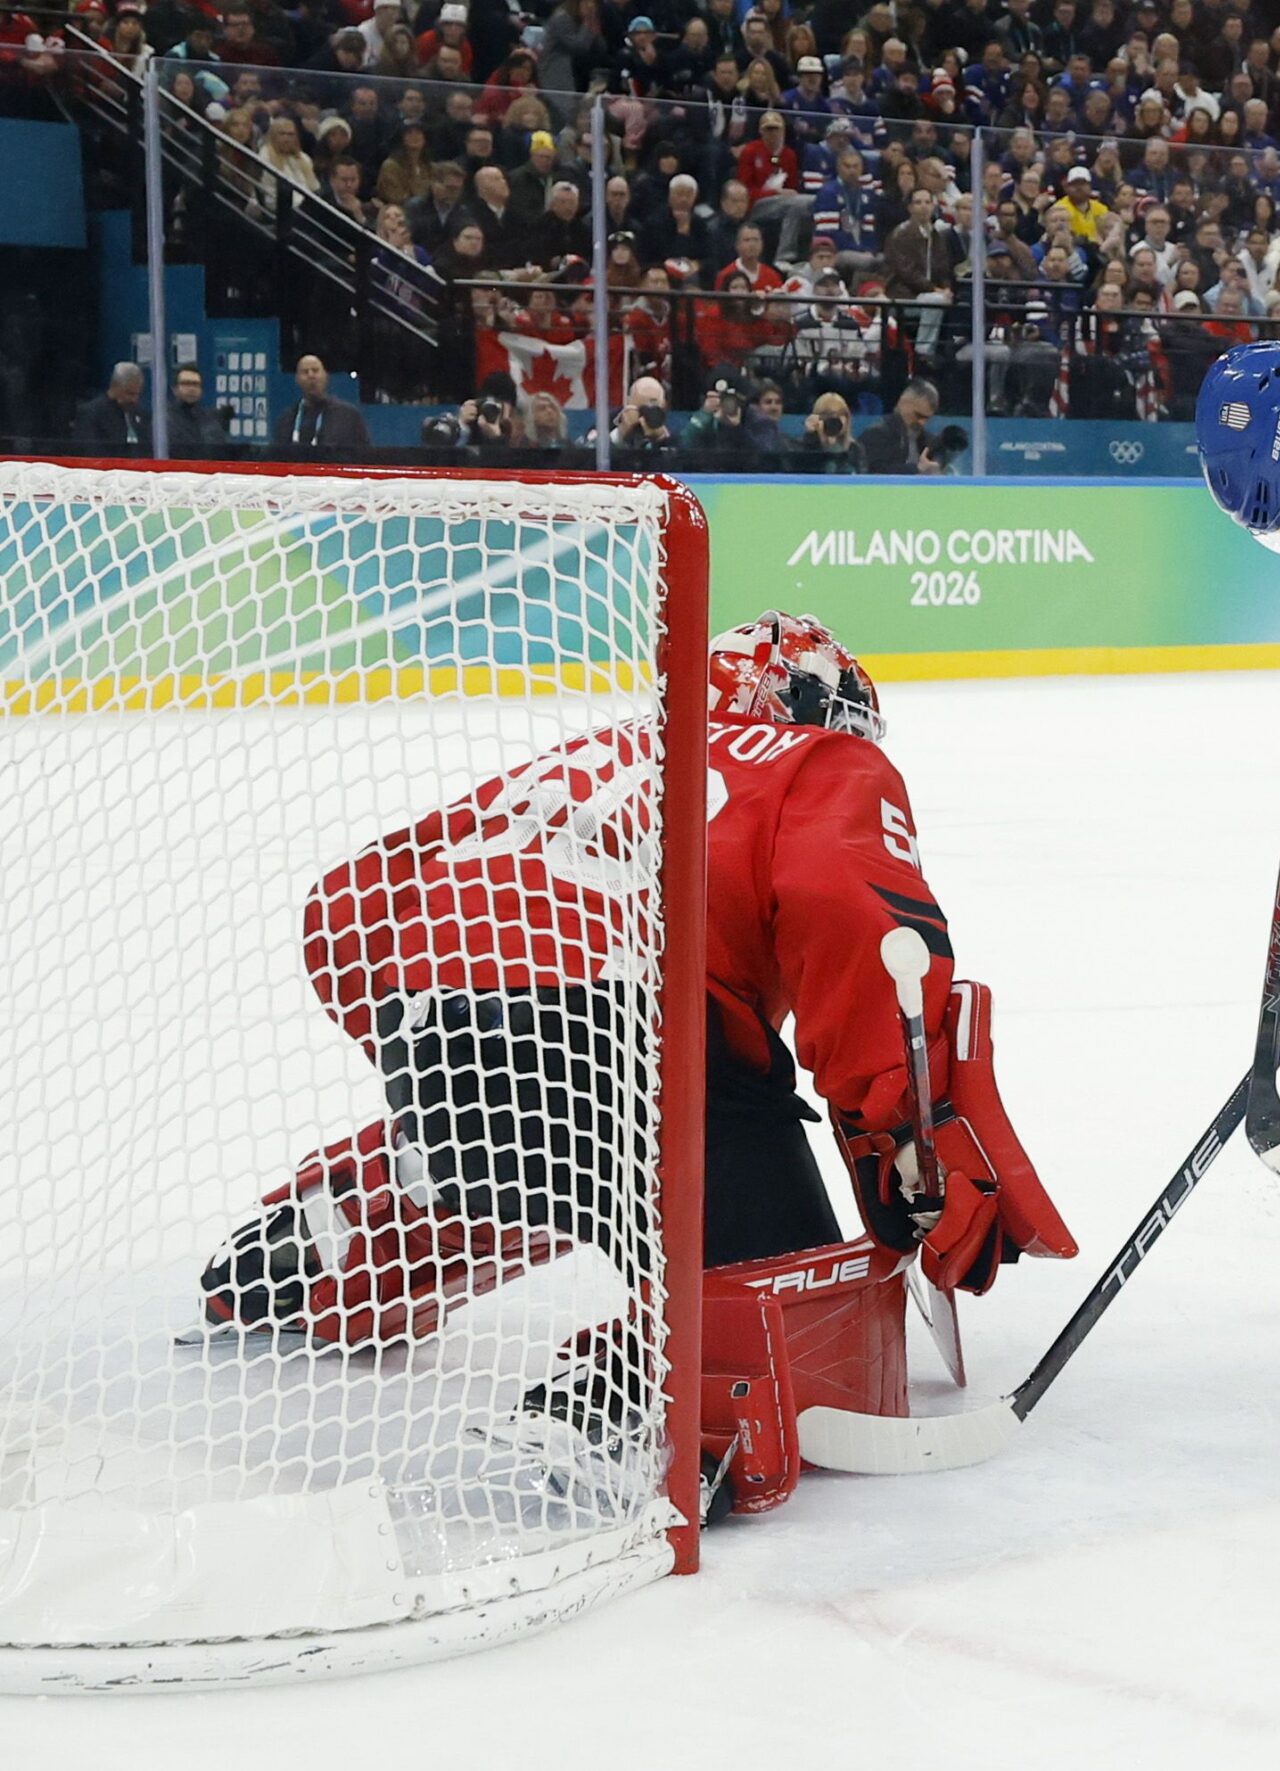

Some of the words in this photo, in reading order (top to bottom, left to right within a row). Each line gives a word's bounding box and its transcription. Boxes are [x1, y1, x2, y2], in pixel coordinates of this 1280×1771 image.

[787, 529, 941, 566] MILANO
[947, 528, 1095, 564] CORTINA
[910, 570, 981, 606] 2026
[880, 797, 922, 871] 5
[1101, 1129, 1223, 1293] TRUE
